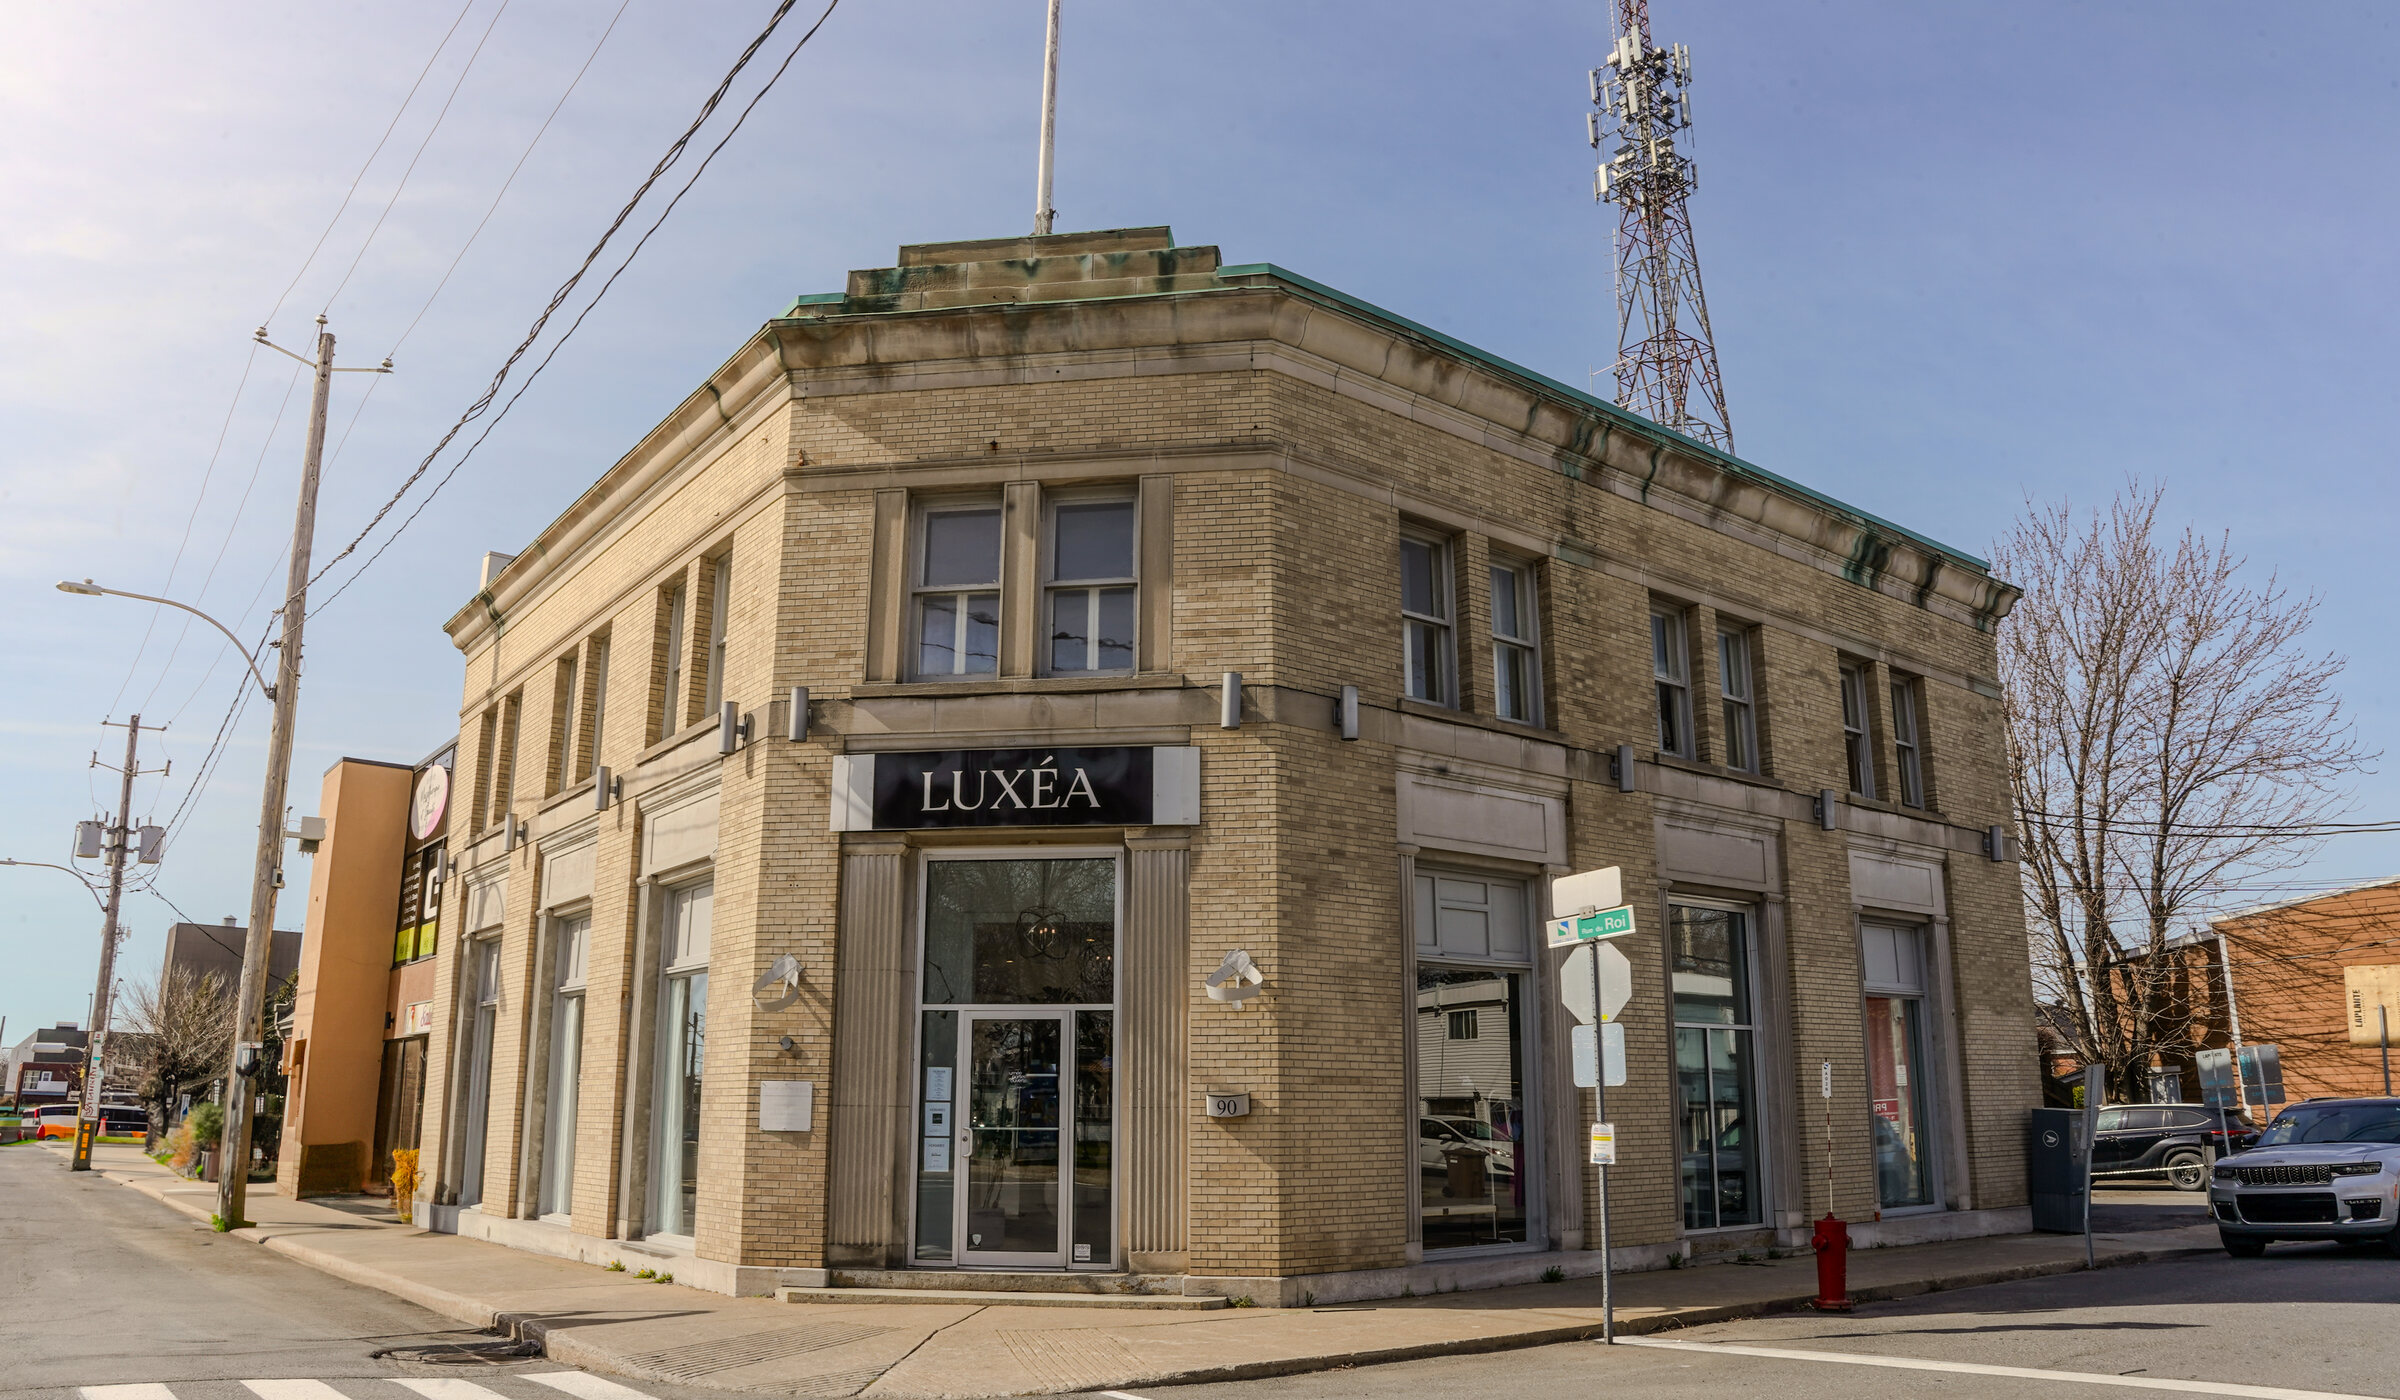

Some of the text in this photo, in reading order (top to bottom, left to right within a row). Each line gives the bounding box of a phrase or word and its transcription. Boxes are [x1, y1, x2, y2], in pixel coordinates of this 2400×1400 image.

[921, 755, 1101, 811] LUXÉA
[1604, 914, 1626, 930] Roi
[1217, 1099, 1237, 1116] 90
